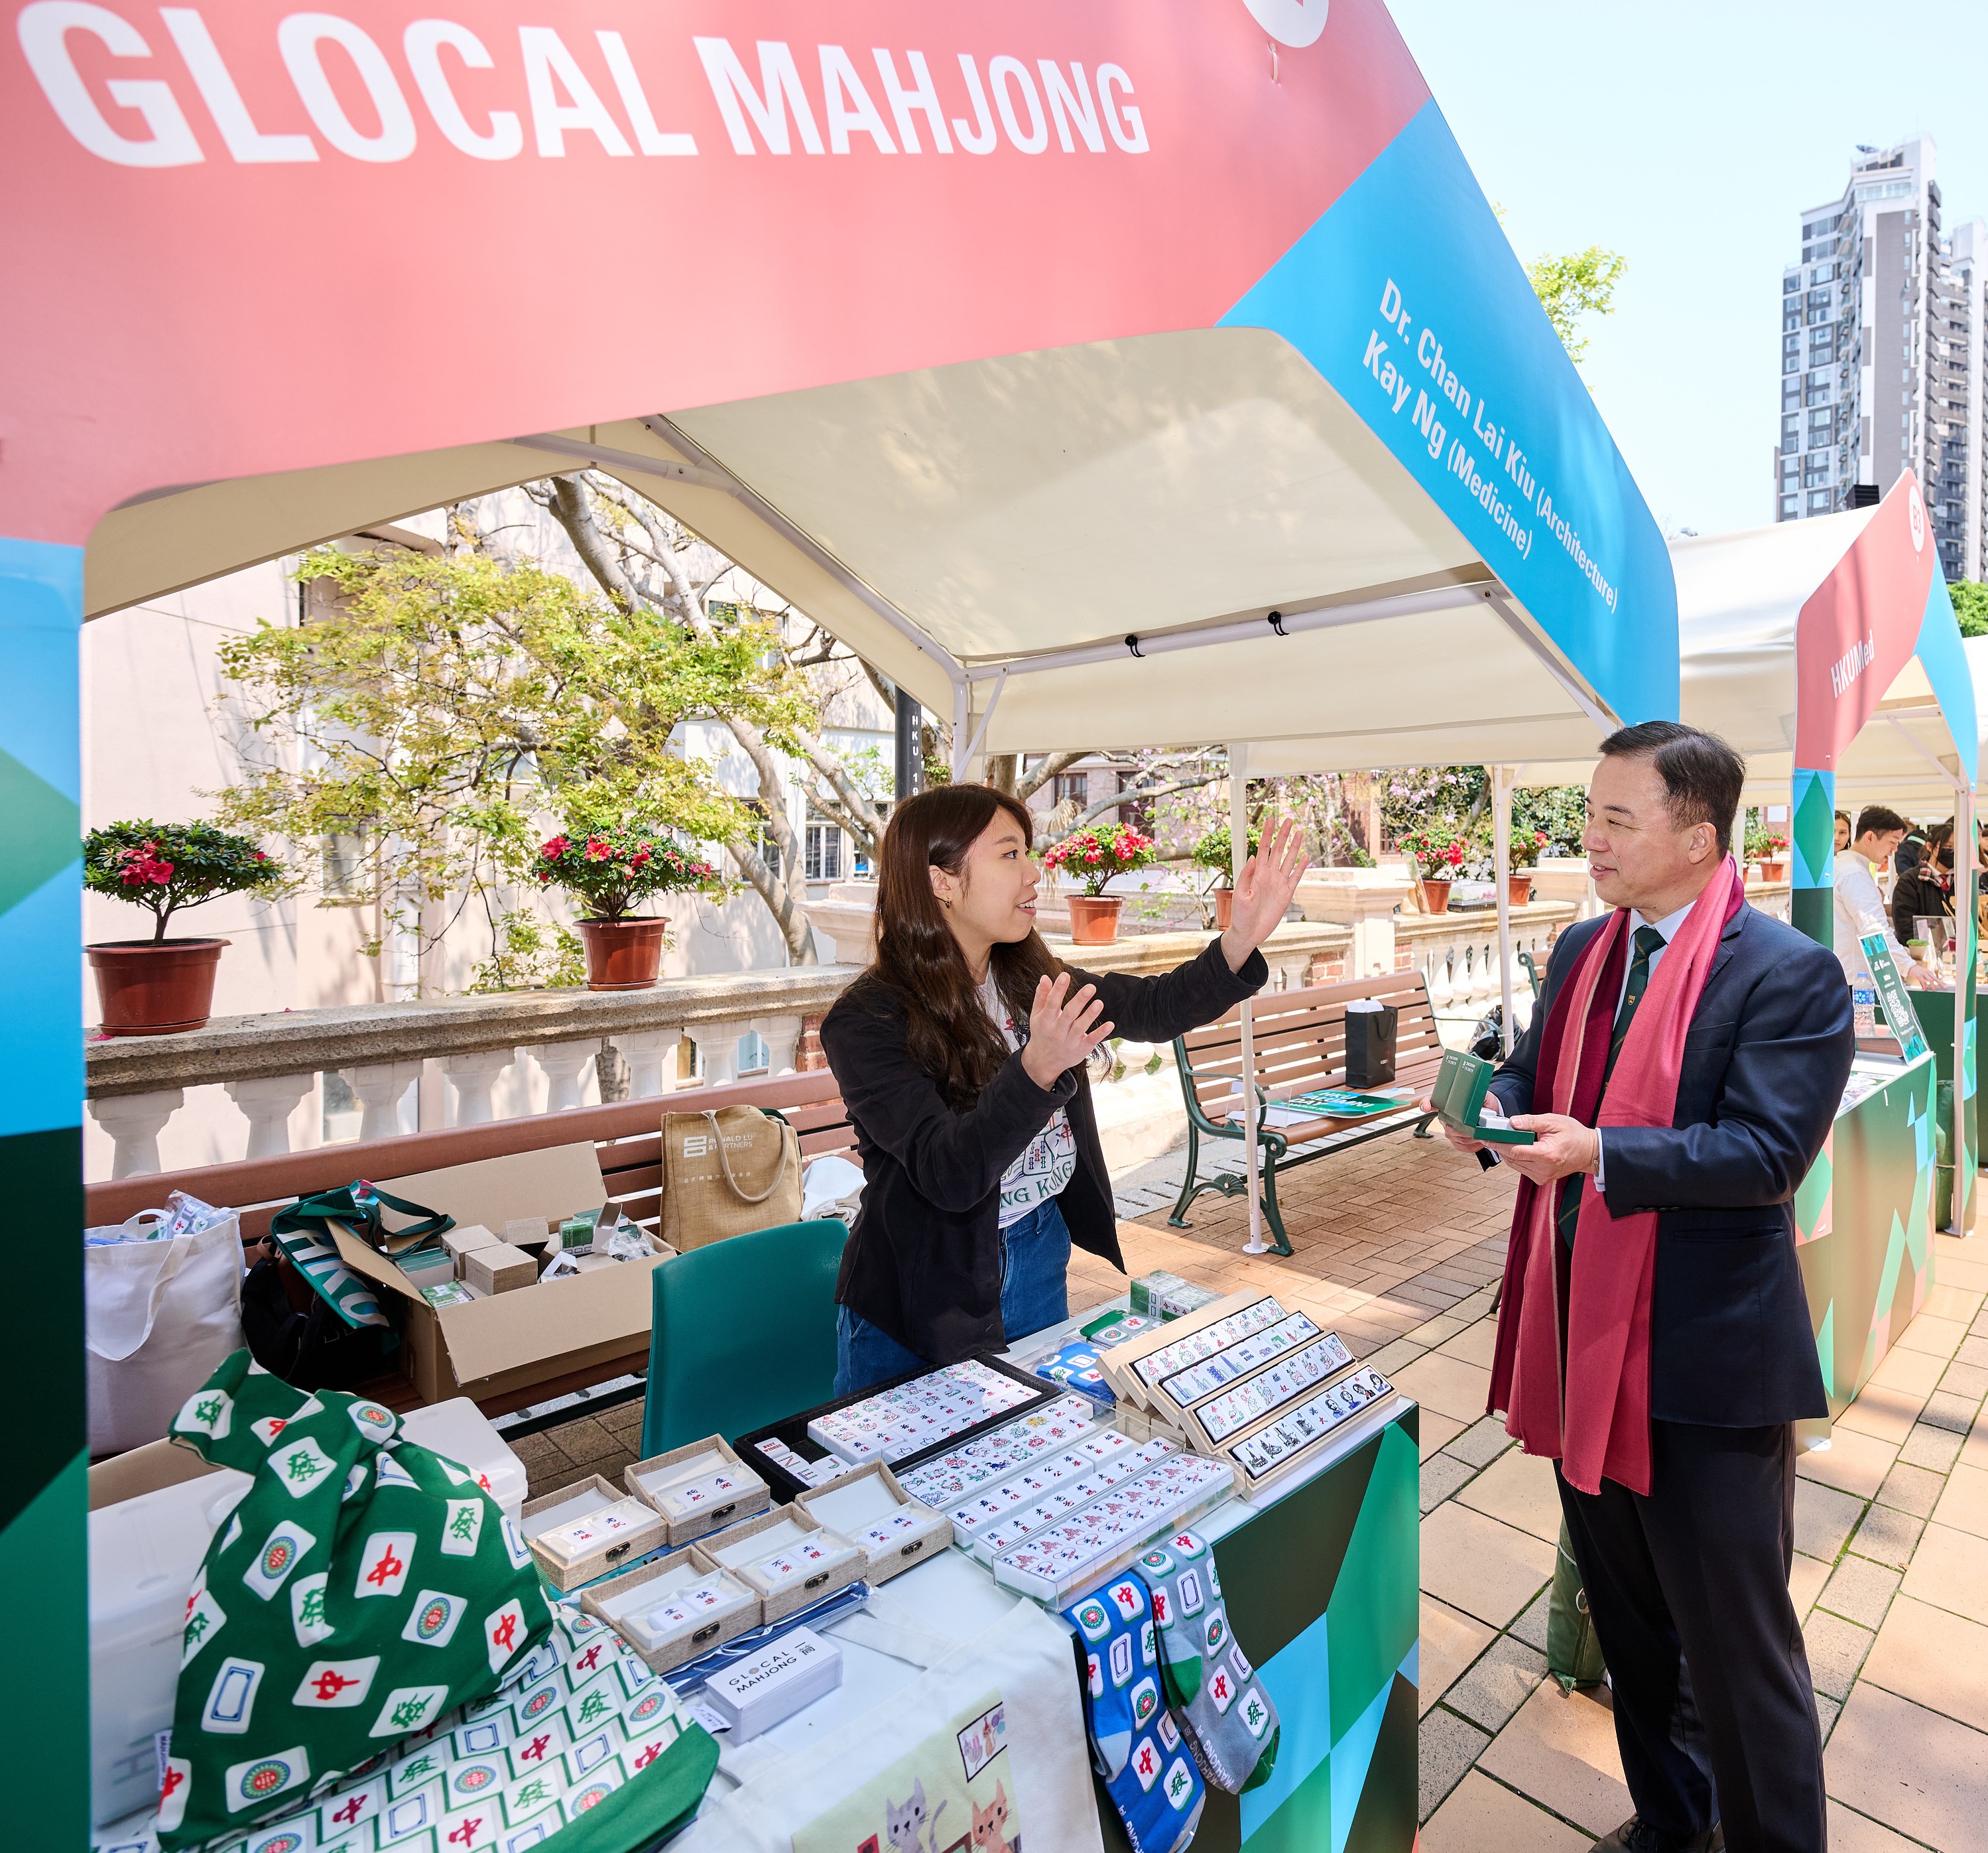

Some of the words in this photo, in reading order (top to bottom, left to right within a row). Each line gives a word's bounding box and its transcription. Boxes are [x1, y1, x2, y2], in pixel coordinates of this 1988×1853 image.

[16, 0, 699, 168] GLOCAL
[692, 36, 1149, 155] MAHJONG
[1363, 329, 1412, 414] Kay
[1412, 389, 1447, 459] Ng
[1447, 438, 1532, 560] (Medicine)
[1379, 278, 1411, 343] Dr.
[1417, 328, 1471, 418] Chan
[1473, 399, 1505, 460] Lai
[1505, 440, 1536, 502] Kiu
[1536, 487, 1618, 614] (Architecture)
[1912, 506, 1922, 535] B3
[1831, 629, 1875, 698] HKUMed
[1304, 1096, 1375, 1108] ALUMNI
[715, 1141, 753, 1150] PRTNERS
[449, 1506, 477, 1543] 發
[1176, 1535, 1194, 1549] 中
[365, 1544, 404, 1587] 中
[1117, 1586, 1135, 1610] 中
[493, 1613, 517, 1653] 中
[577, 1645, 601, 1671] 中
[310, 1669, 360, 1701] 中
[736, 1657, 797, 1693] MAHJONG
[1214, 1673, 1231, 1700] 中
[578, 1689, 613, 1724] 發
[521, 1734, 551, 1761] 中
[1139, 1747, 1154, 1775] 中
[1203, 1739, 1235, 1789] MAHJONG
[333, 1795, 368, 1824] 中
[448, 1818, 483, 1848] 中
